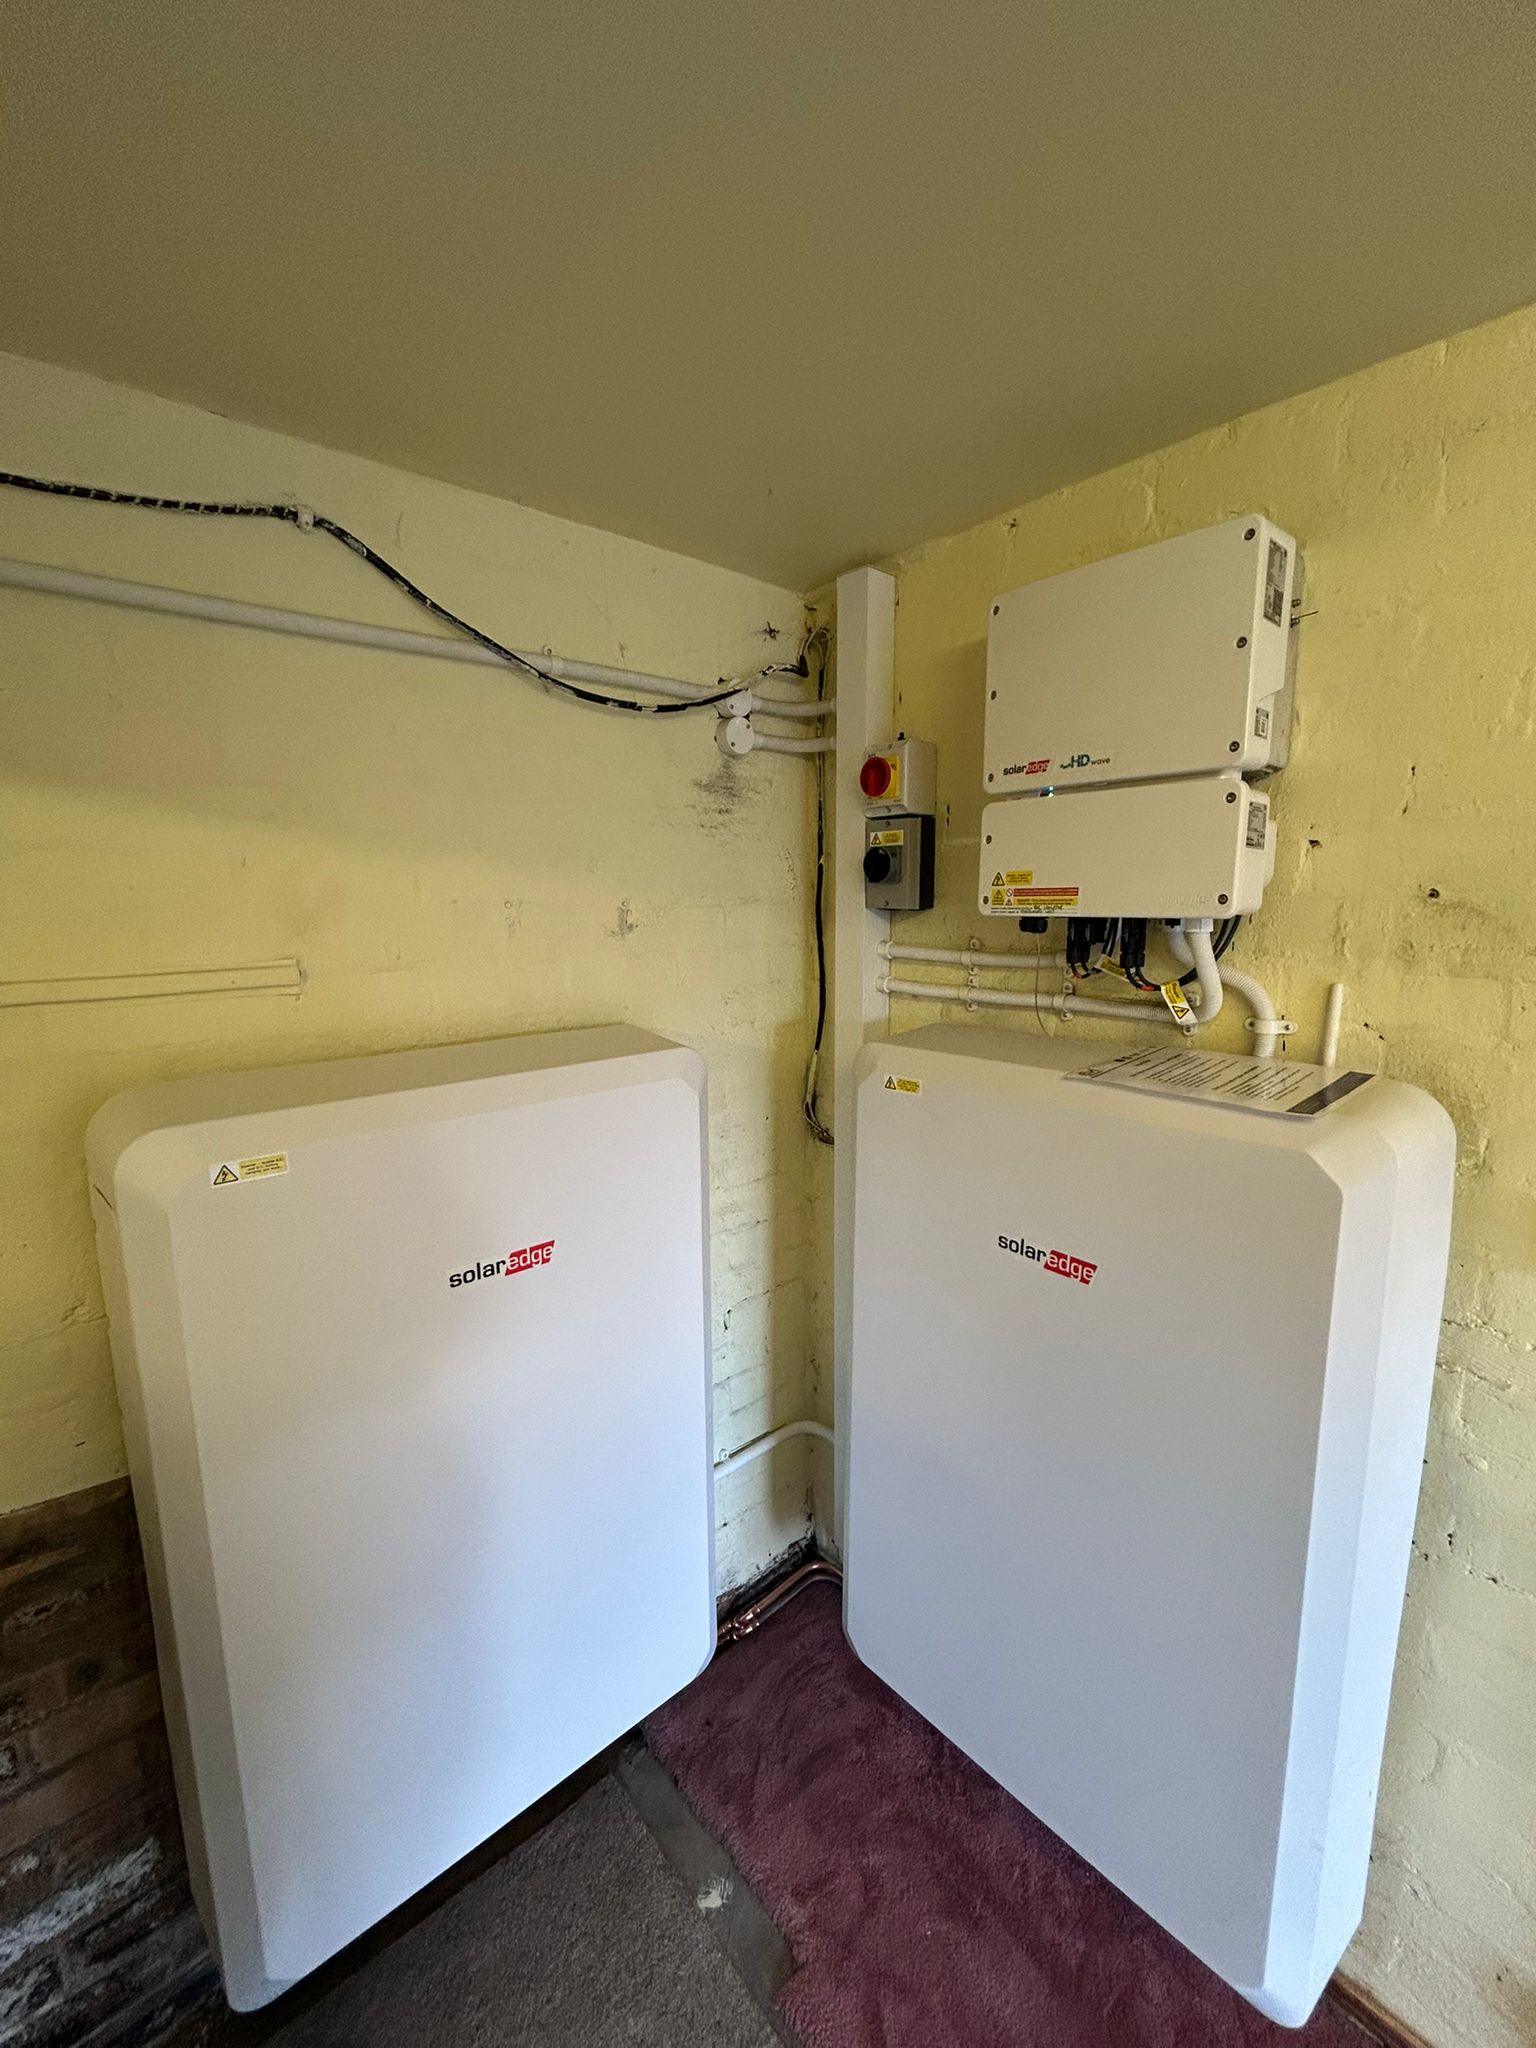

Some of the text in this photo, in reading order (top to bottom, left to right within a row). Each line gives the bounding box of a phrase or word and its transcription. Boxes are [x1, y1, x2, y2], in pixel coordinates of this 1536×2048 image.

[1003, 760, 1050, 775] solaredge
[449, 1241, 555, 1288] solaredge
[998, 1235, 1096, 1283] solaredge
